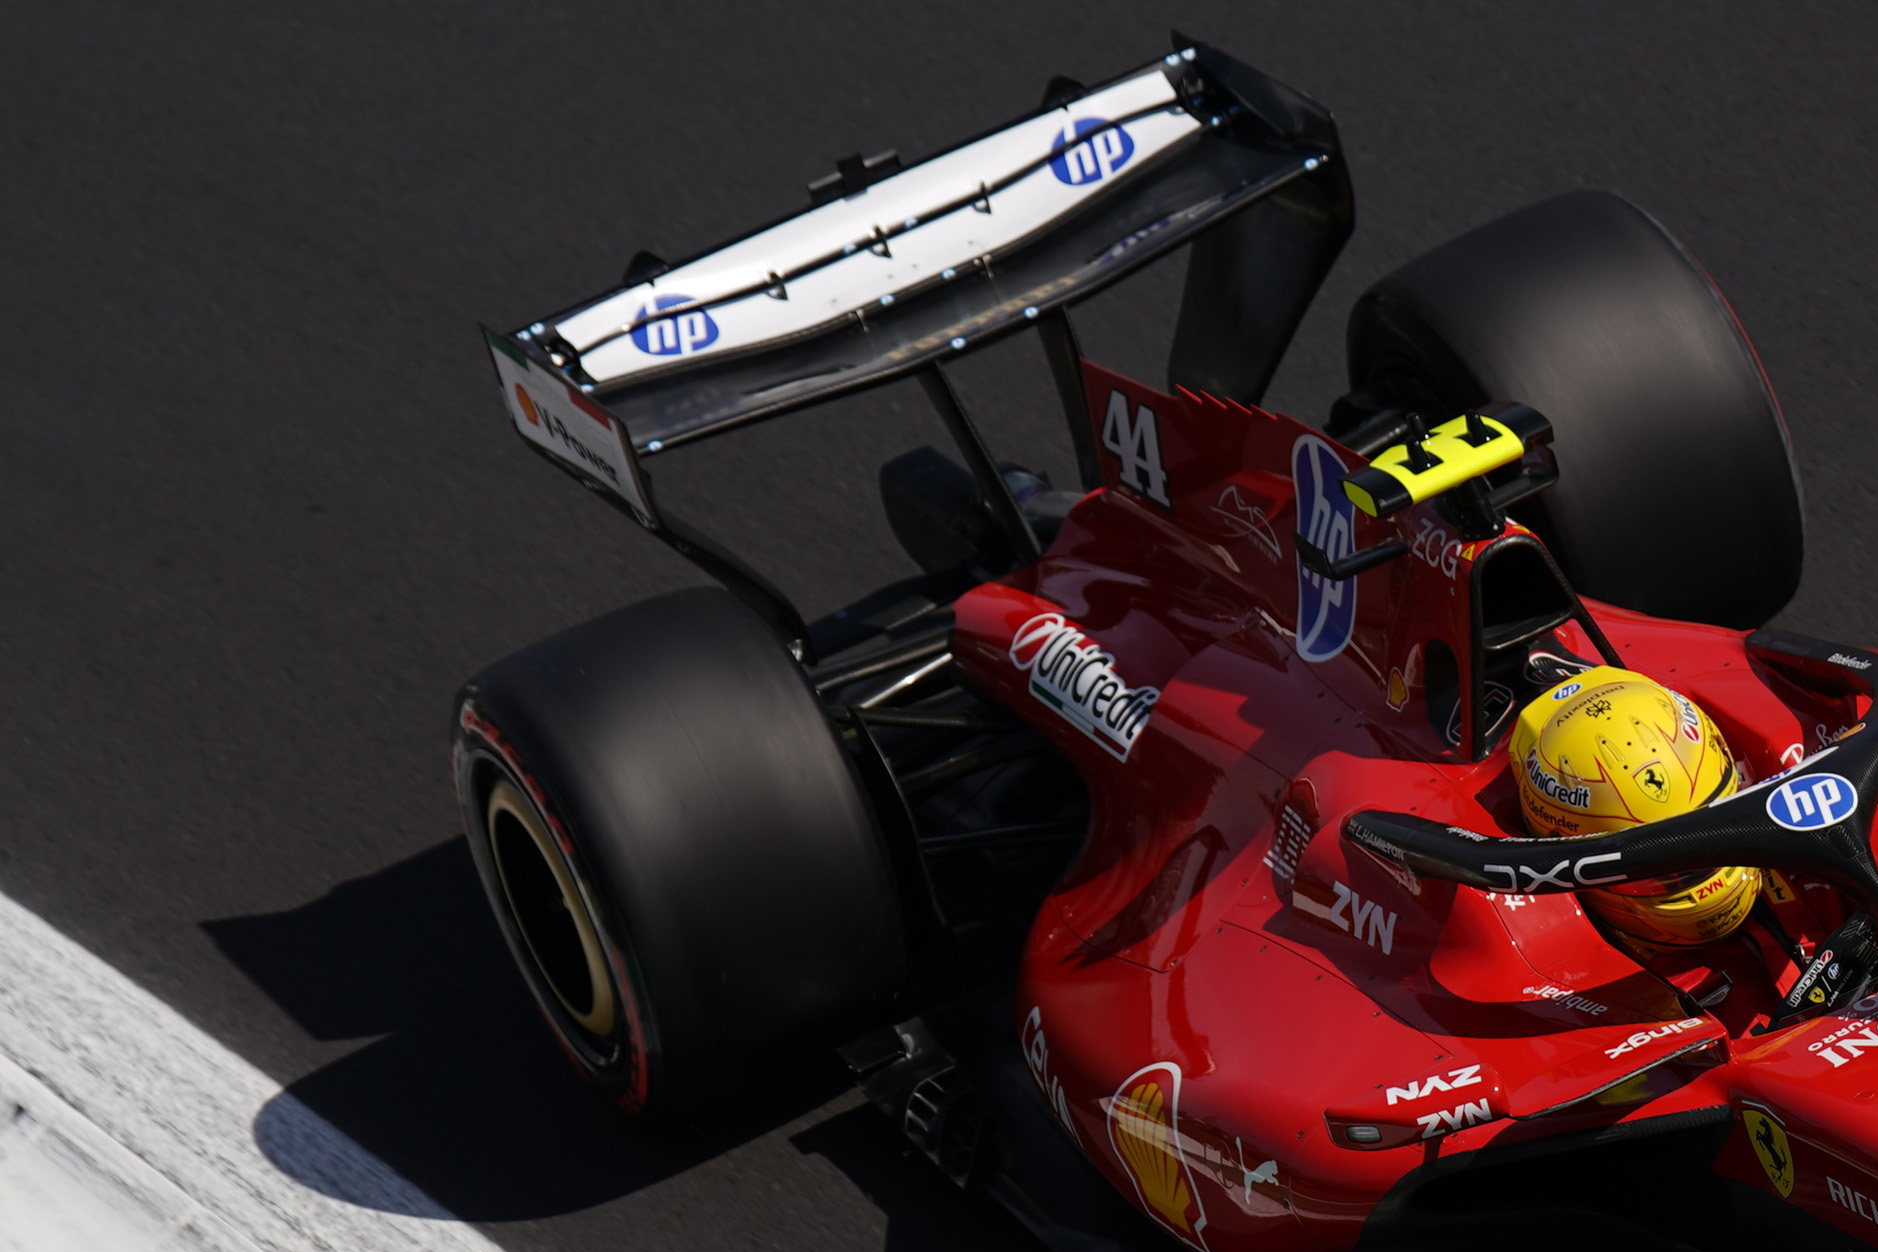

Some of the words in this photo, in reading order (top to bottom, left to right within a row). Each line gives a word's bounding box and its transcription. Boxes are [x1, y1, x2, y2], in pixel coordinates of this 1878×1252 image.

[1058, 117, 1128, 185] hp
[635, 294, 714, 355] hp
[1103, 389, 1171, 510] 44
[1296, 435, 1352, 662] hp
[1037, 628, 1152, 741] UniCredit
[1530, 758, 1590, 808] UniCredit
[1782, 772, 1846, 831] hp
[1328, 881, 1397, 955] ZYN
[1695, 878, 1726, 900] ZYN
[1385, 1064, 1482, 1106] ZYN
[1417, 1098, 1493, 1139] ZYN
